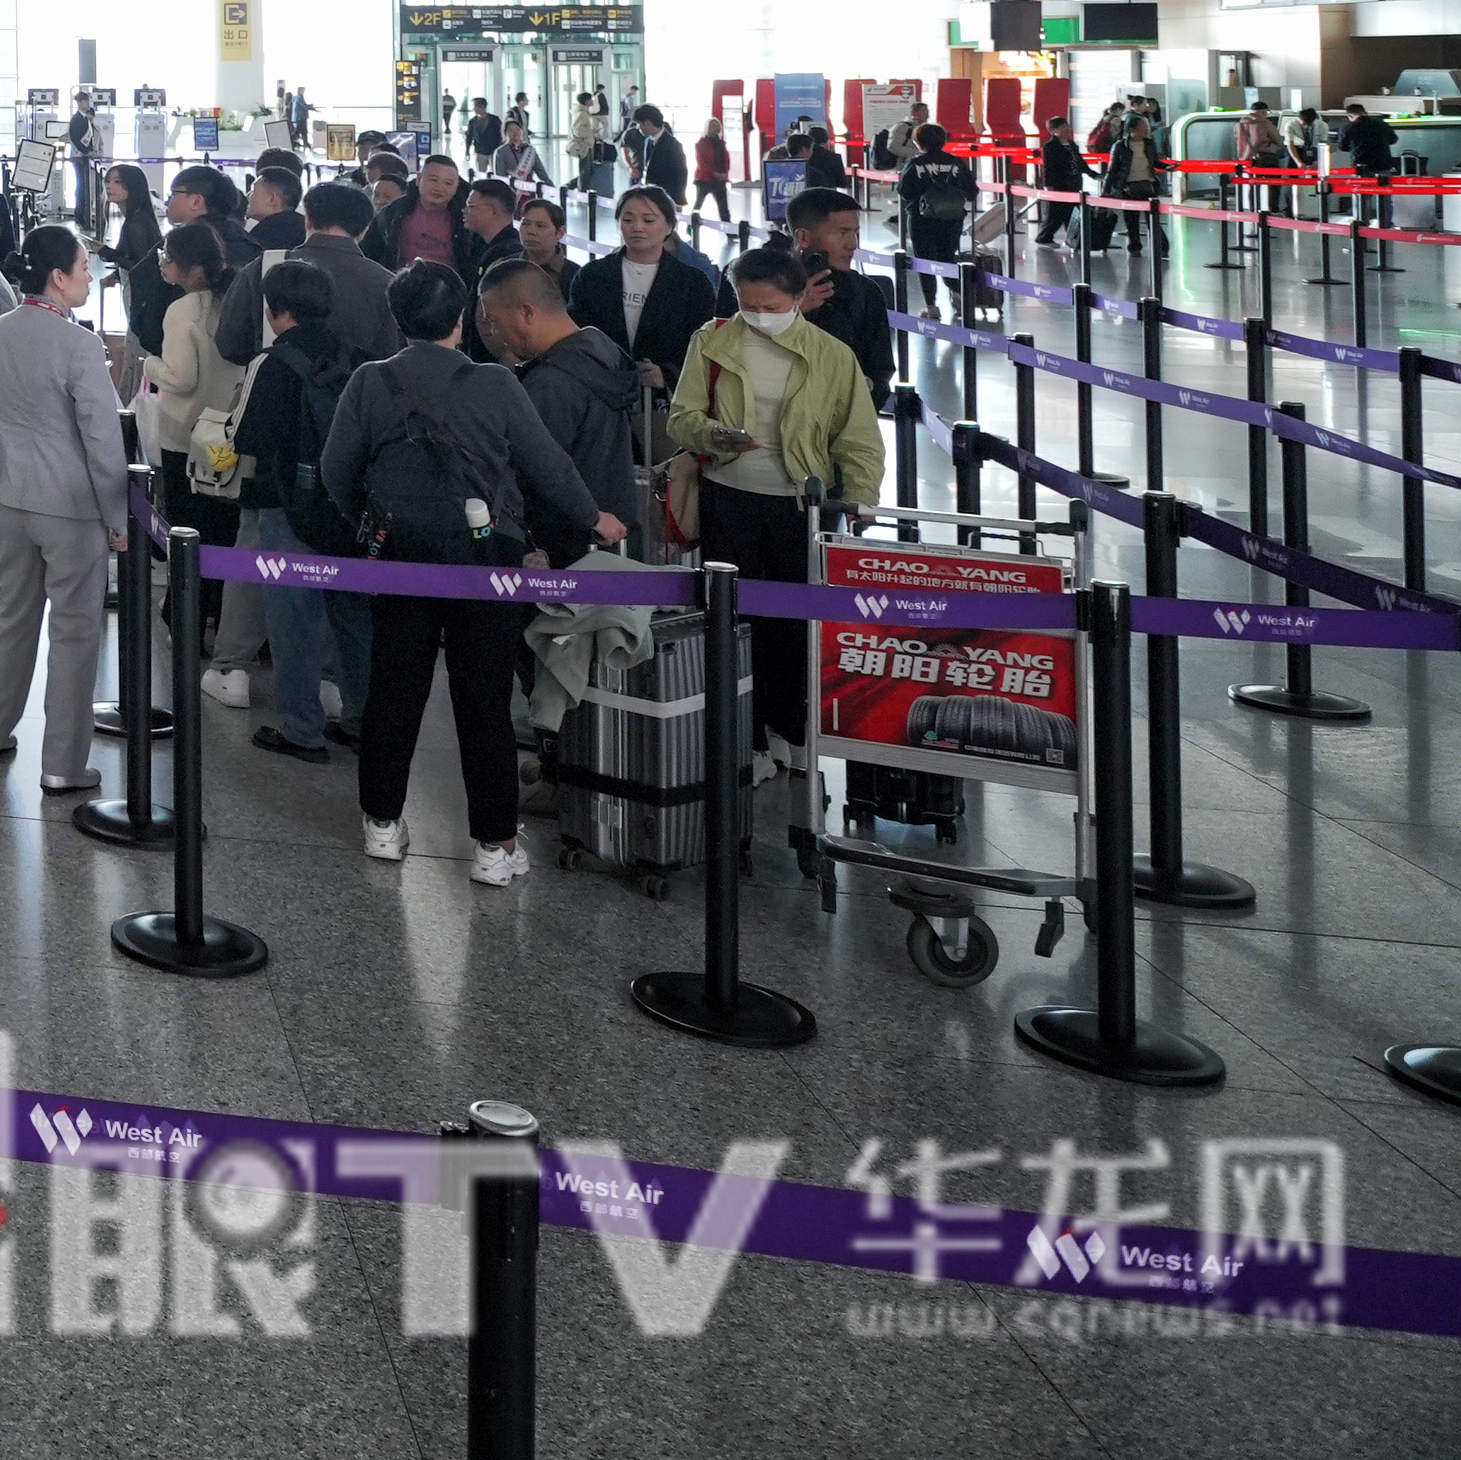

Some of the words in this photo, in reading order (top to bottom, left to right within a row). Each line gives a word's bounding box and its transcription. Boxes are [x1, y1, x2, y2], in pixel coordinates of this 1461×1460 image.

[424, 13, 441, 25] 2F
[544, 13, 560, 25] 1F
[224, 29, 248, 39] 出口
[291, 562, 323, 574] West
[324, 564, 339, 576] Air
[858, 558, 929, 574] CHAO
[957, 566, 1026, 583] YANG
[528, 576, 559, 589] West
[561, 579, 578, 590] Air
[896, 599, 926, 611] West
[929, 600, 947, 612] Air
[1258, 614, 1292, 626] West
[1295, 617, 1315, 628] Air
[837, 632, 927, 654] CHAO
[963, 646, 1054, 670] YANG
[838, 647, 1052, 698] 朝阳轮胎
[105, 1119, 163, 1144] West
[168, 1127, 203, 1148] Air
[128, 1147, 180, 1163] 西部航空
[555, 1171, 619, 1199] West
[625, 1181, 664, 1205] Air
[580, 1200, 638, 1220] 西部航空
[1121, 1244, 1193, 1272] West
[1200, 1254, 1245, 1277] Air
